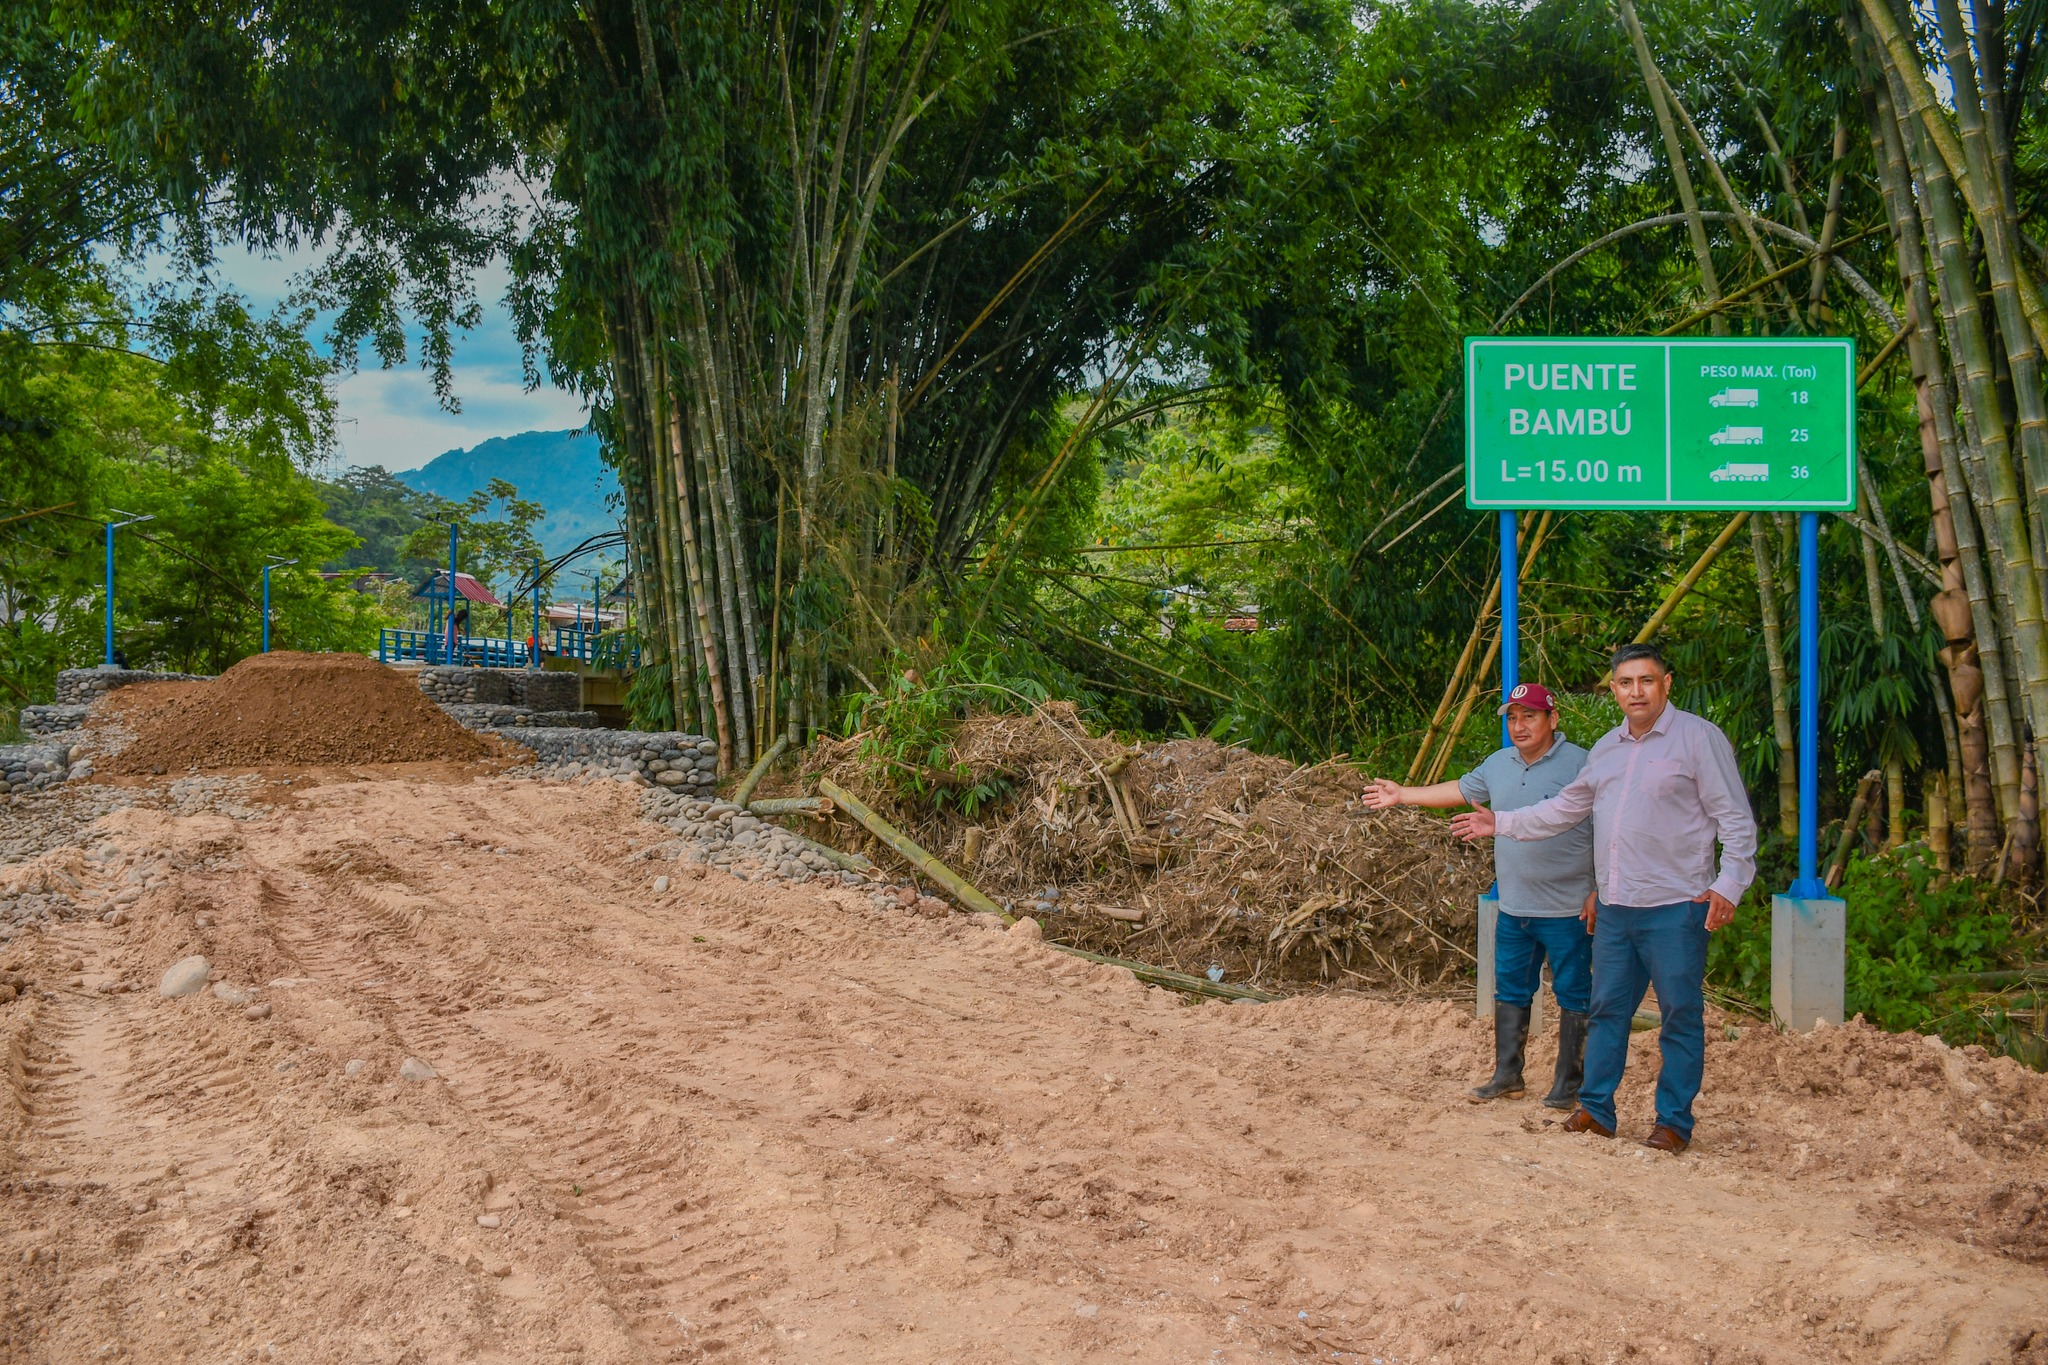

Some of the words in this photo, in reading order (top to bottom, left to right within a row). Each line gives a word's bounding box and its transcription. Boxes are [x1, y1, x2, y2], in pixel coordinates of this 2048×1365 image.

[1504, 363, 1637, 391] PUENTE
[1700, 365, 1738, 379] PESO
[1741, 365, 1778, 379] MAX.
[1782, 365, 1817, 381] (Ton)
[1790, 391, 1809, 405] 18
[1509, 402, 1632, 436] BAMBÚ
[1790, 429, 1809, 443] 25
[1501, 459, 1609, 483] L=15.00
[1617, 464, 1642, 483] m
[1790, 466, 1809, 480] 36
